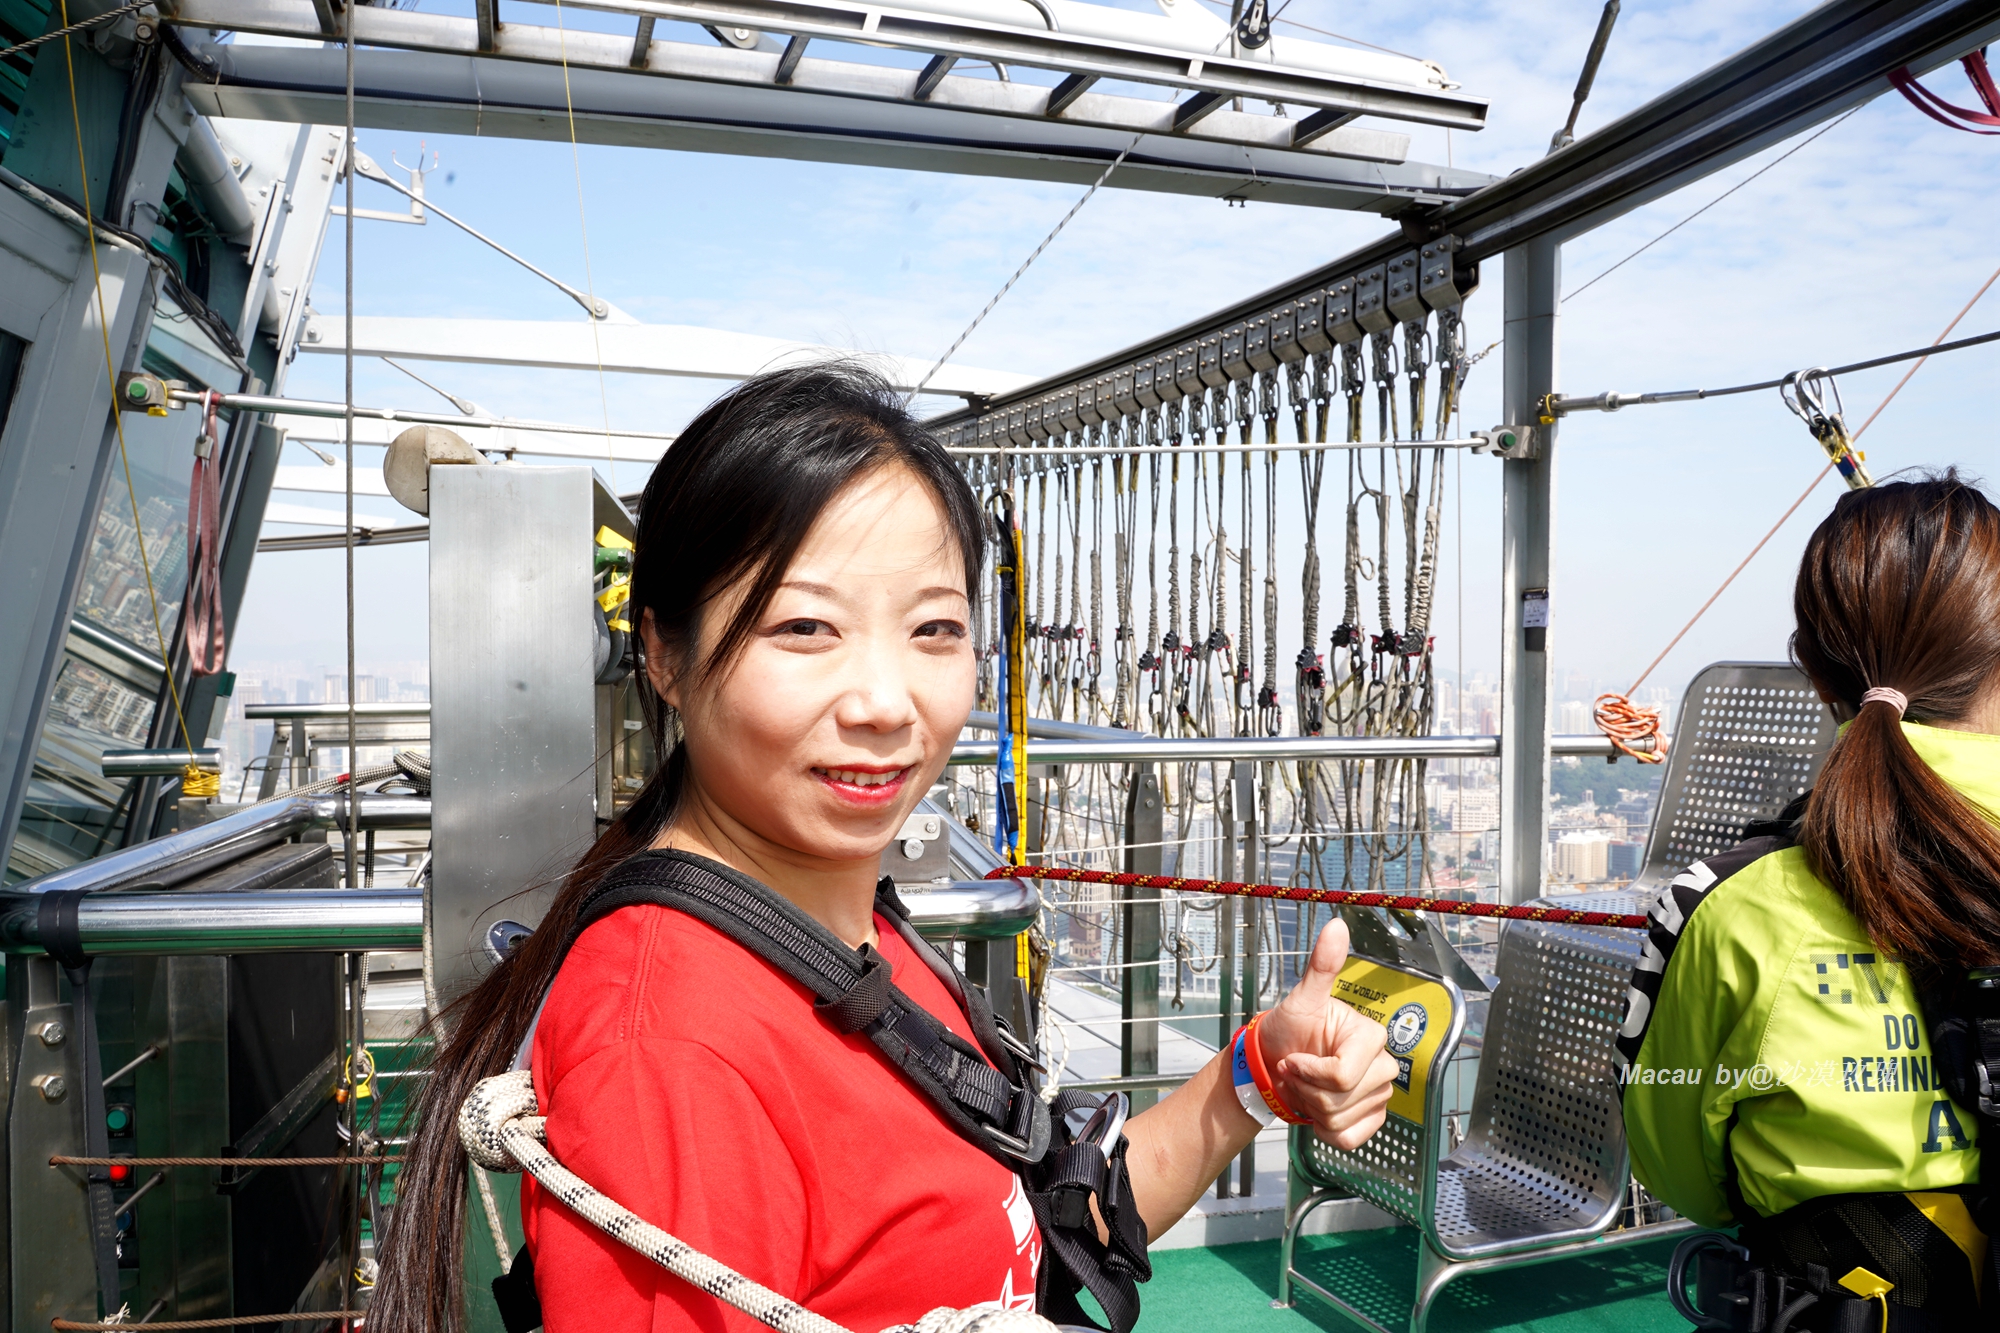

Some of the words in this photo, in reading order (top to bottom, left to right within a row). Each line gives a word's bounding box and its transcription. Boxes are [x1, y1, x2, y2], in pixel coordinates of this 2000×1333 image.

[1336, 979, 1352, 992] THE
[1353, 984, 1388, 1004] WORLD'S
[1398, 1005, 1426, 1024] GUINNESS
[1387, 1020, 1397, 1048] WORLD
[1394, 1029, 1424, 1052] RECORDS
[1883, 1013, 1920, 1050] DO
[1260, 1088, 1294, 1120] DEFY
